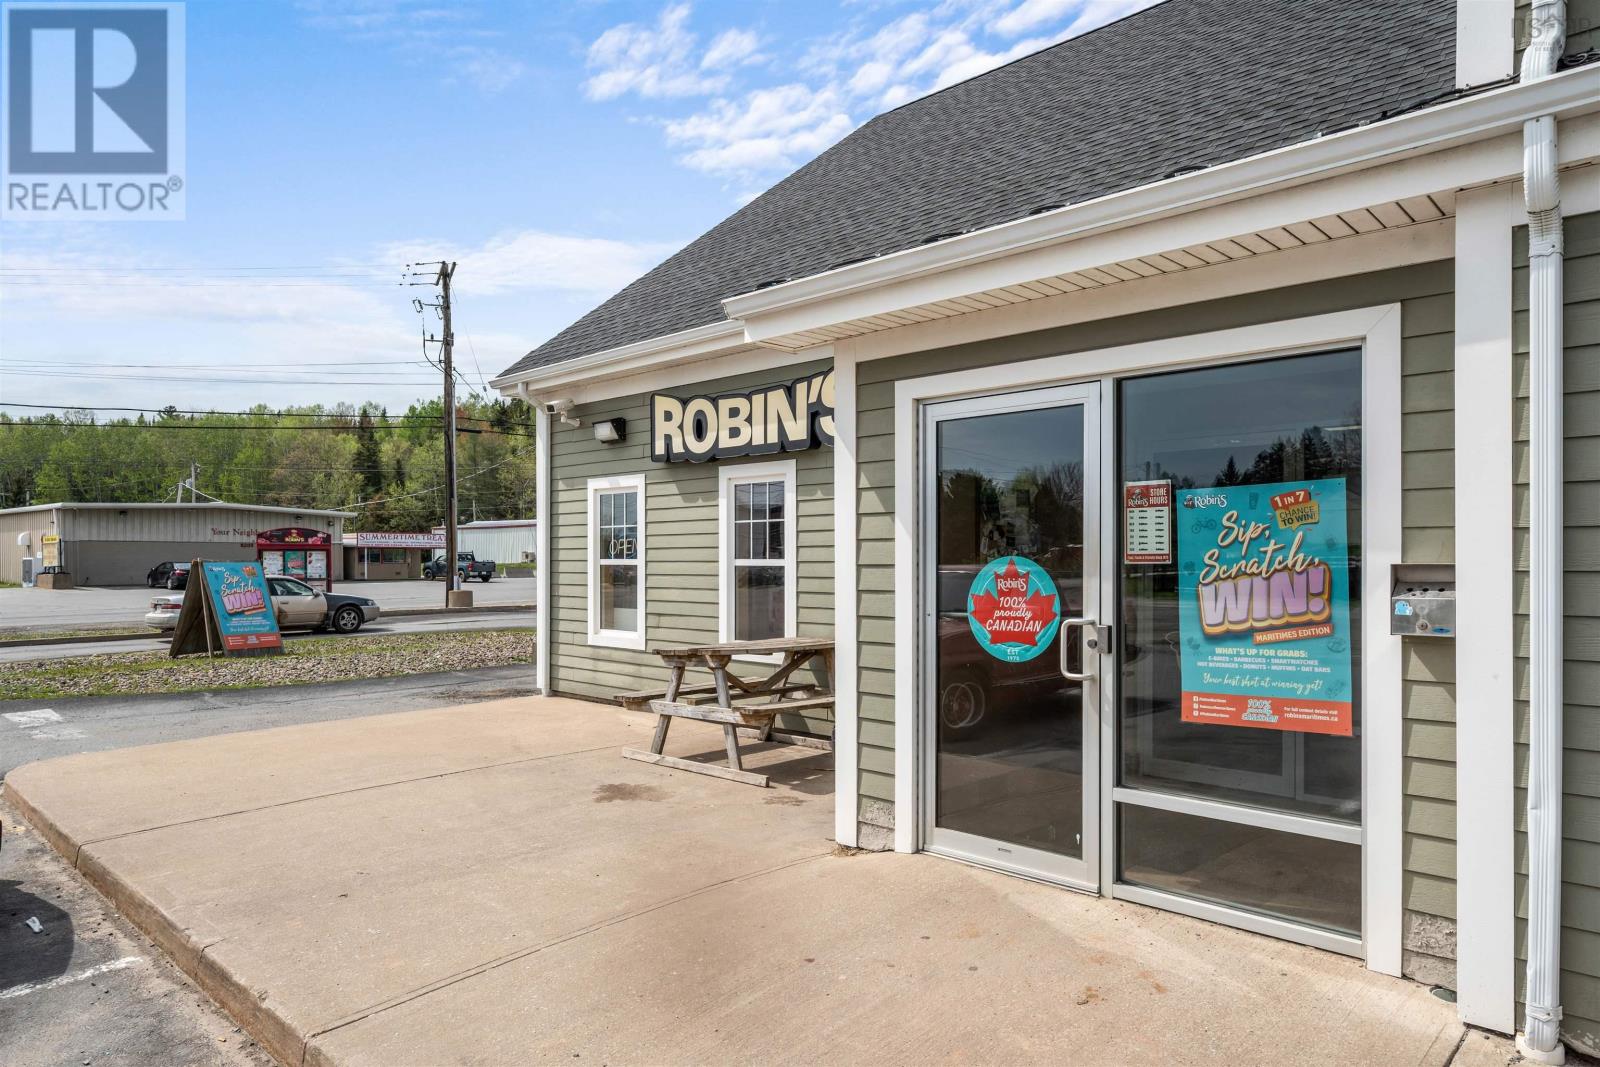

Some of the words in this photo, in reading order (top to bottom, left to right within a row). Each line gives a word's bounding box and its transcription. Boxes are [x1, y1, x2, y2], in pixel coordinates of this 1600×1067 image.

[1150, 488, 1167, 496] STORE
[1149, 496, 1168, 505] HOURS
[1274, 497, 1283, 508] 1
[1284, 496, 1294, 504] IN
[1295, 490, 1305, 502] 7
[1279, 506, 1315, 519] CHANCE
[1281, 517, 1294, 527] TO
[1295, 513, 1317, 523] WIN!
[211, 528, 230, 536] Your
[359, 533, 420, 541] SUMMERTIME
[1217, 510, 1271, 556] Sip,
[1200, 531, 1319, 584] Scratch,
[999, 597, 1027, 608] 100%
[1201, 565, 1327, 627] WIN!
[993, 609, 1032, 620] proudly
[986, 619, 1042, 632] CANADIAN
[1256, 631, 1298, 642] MARITIMES
[1298, 626, 1330, 638] EDITION
[1215, 647, 1244, 655] WHAT'S
[1259, 648, 1275, 656] FOR
[1277, 649, 1308, 658] GRABS:
